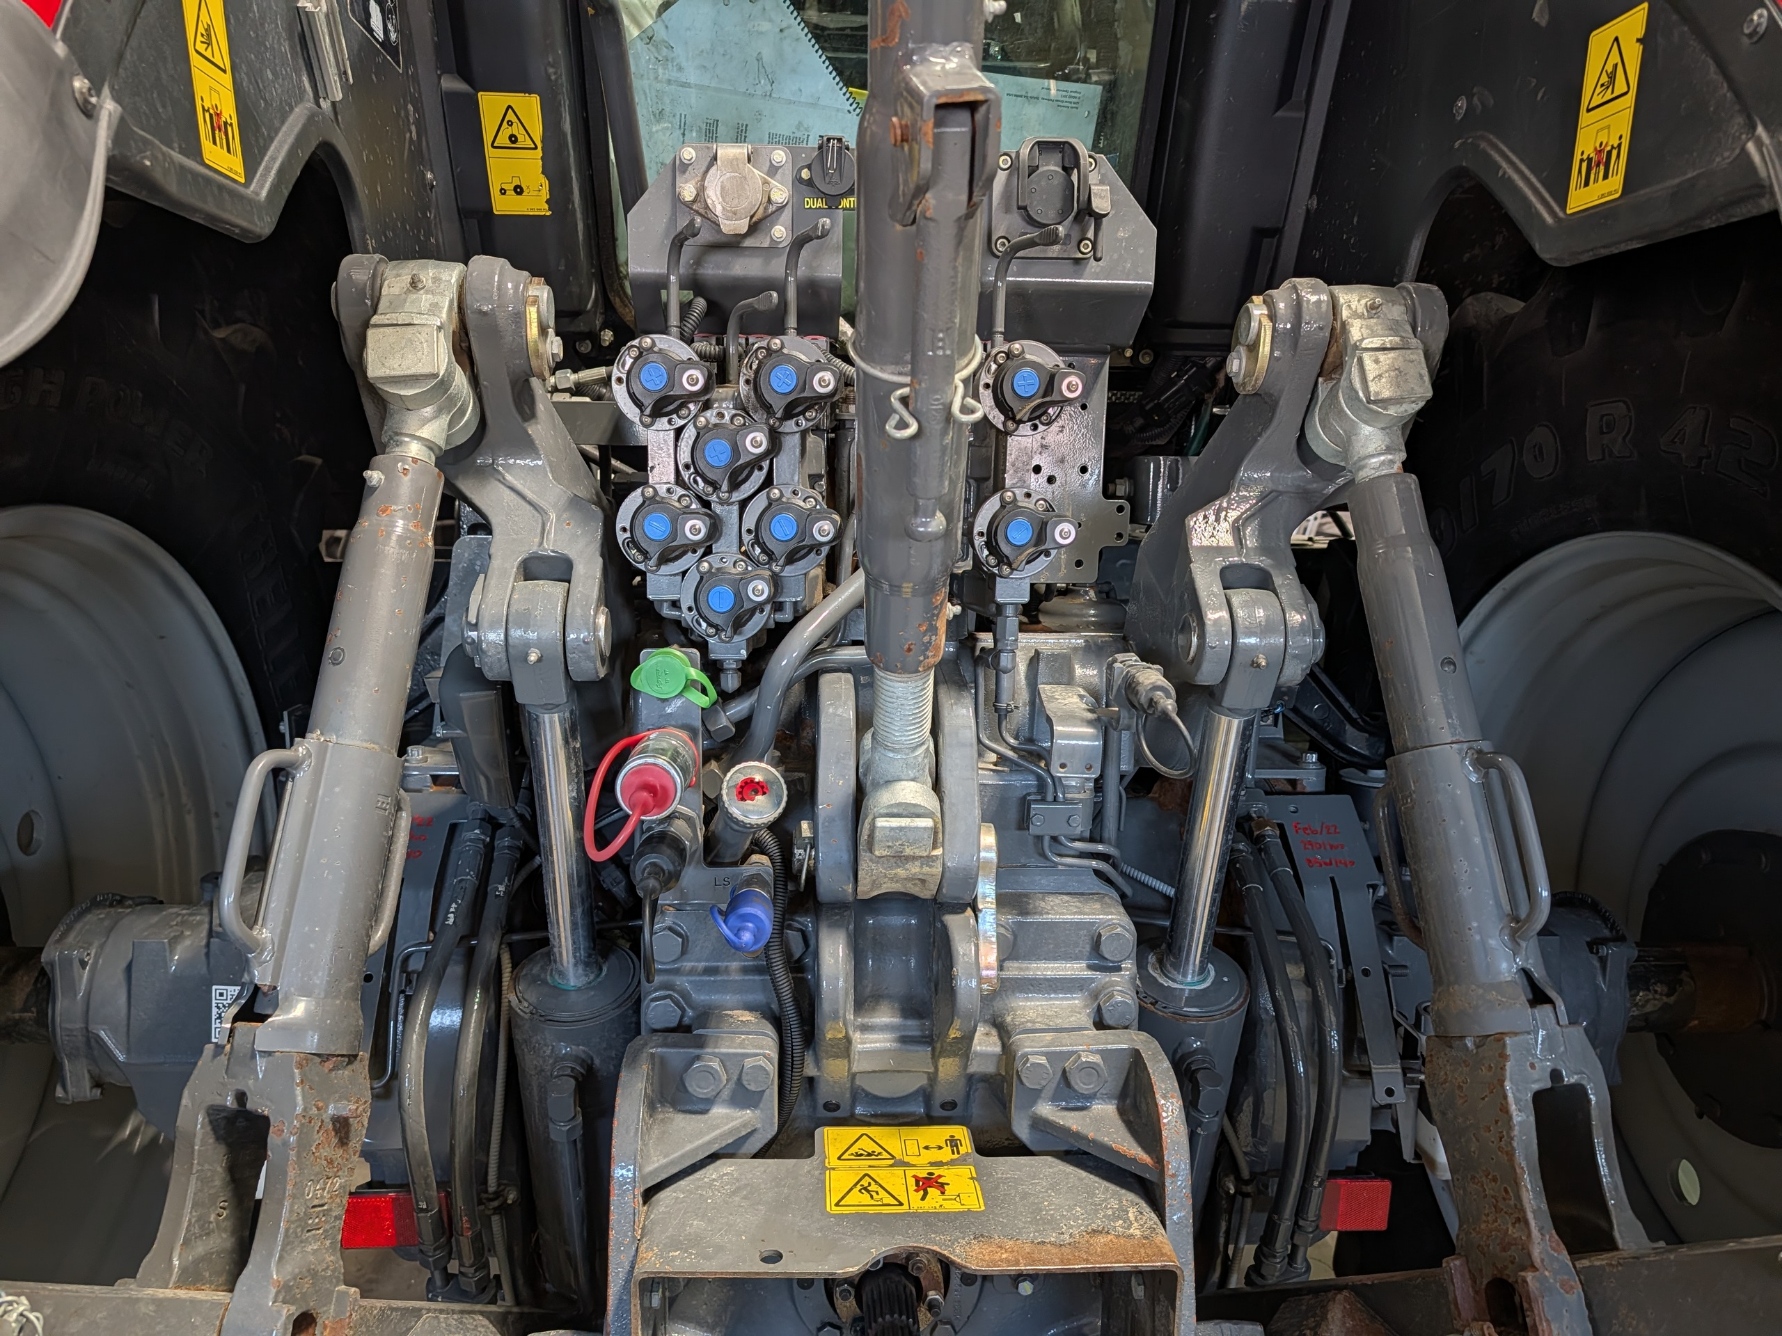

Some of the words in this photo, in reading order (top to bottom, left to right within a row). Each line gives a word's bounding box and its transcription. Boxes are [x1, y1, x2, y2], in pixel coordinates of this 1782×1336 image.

[804, 197, 828, 209] DUAL
[1585, 397, 1637, 462] R
[1659, 403, 1779, 499] 42
[1292, 821, 1341, 836] Feb/22
[714, 876, 731, 887] LS
[217, 1199, 229, 1220] S
